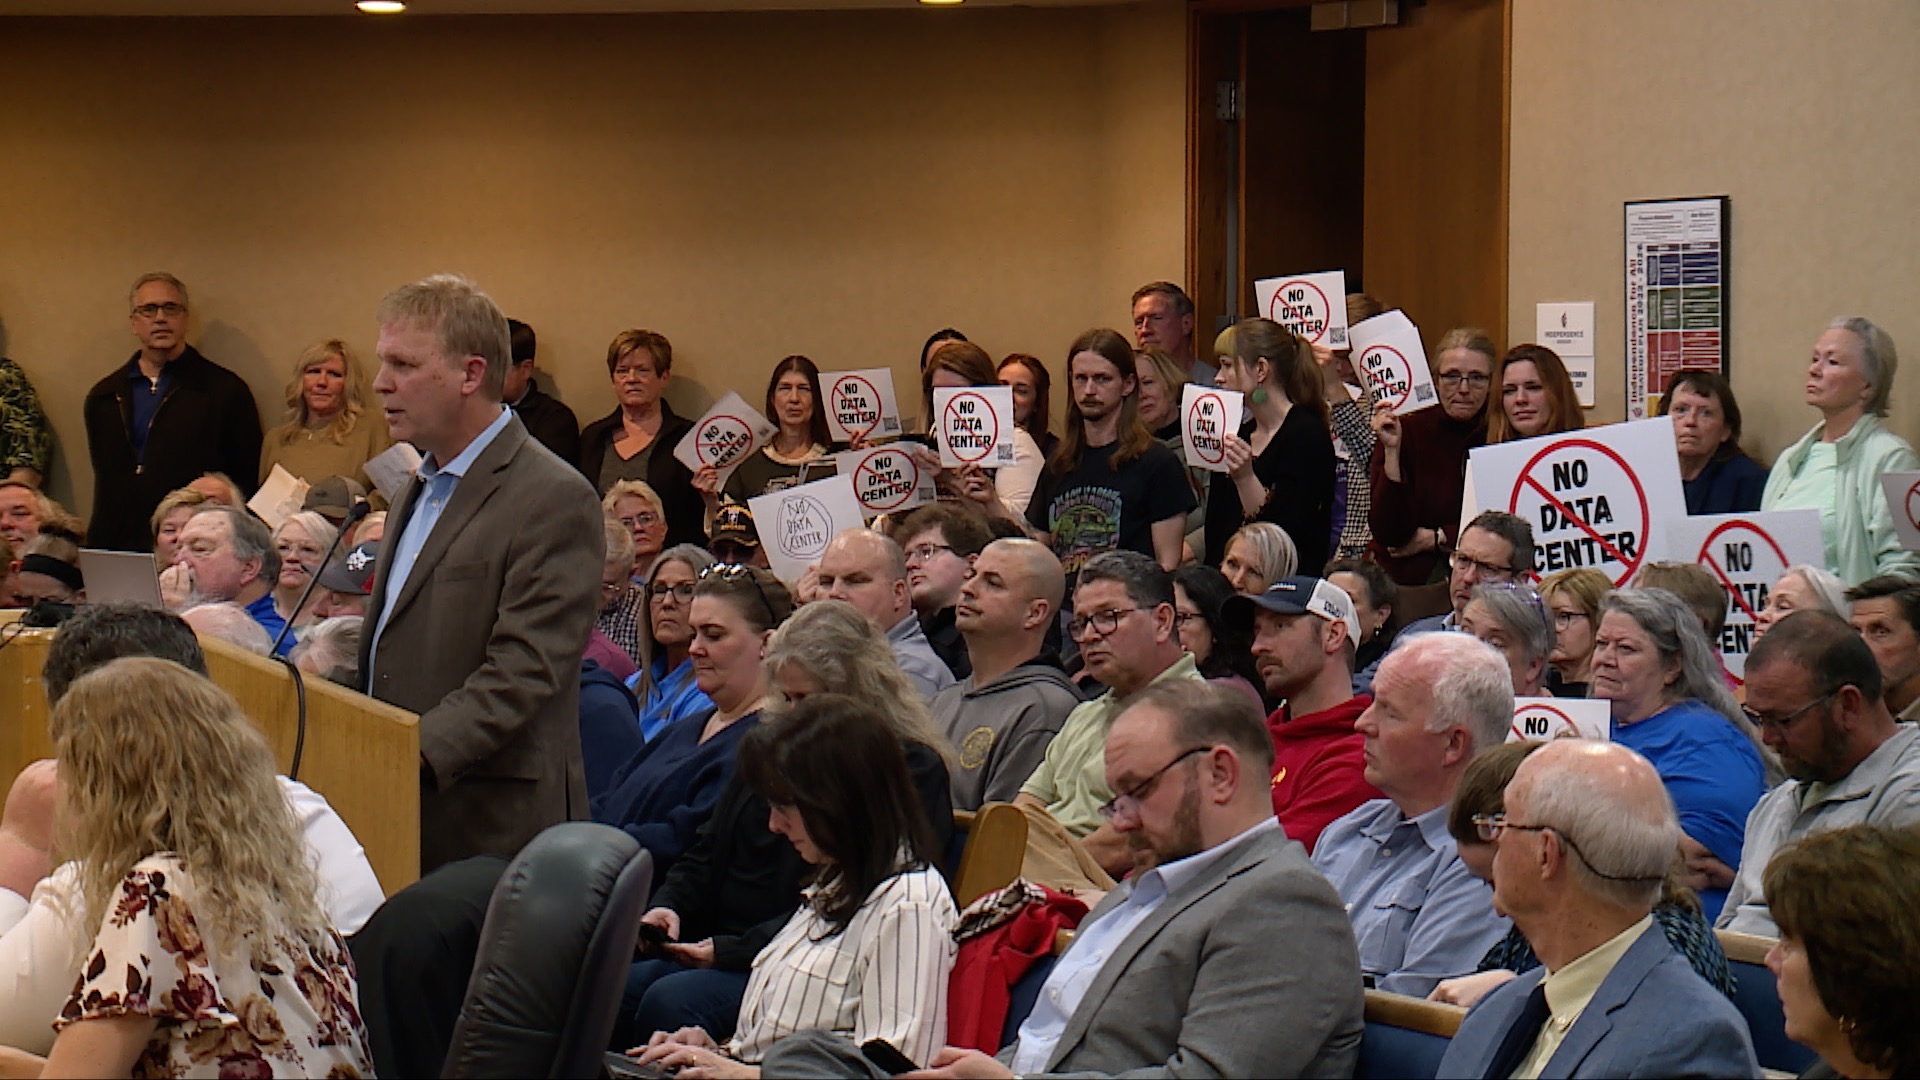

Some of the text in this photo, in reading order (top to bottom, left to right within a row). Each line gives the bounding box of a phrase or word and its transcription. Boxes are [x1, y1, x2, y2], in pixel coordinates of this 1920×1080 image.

[1288, 289, 1304, 302] NO
[1282, 304, 1313, 320] DATA
[1284, 319, 1323, 335] ENTER
[1629, 259, 1637, 403] Independence for All
[1367, 353, 1381, 369] NO
[1367, 367, 1394, 388] DATA
[845, 383, 858, 394] NO
[1371, 381, 1408, 400] ENTER
[841, 397, 867, 410] DATA
[959, 401, 975, 414] NO
[1202, 402, 1214, 416] NO
[838, 411, 877, 424] CENTER
[953, 417, 982, 430] DATA
[704, 425, 719, 441] NO
[1197, 419, 1216, 434] DATA
[709, 431, 736, 457] DATA
[949, 435, 991, 448] CENTER
[1193, 435, 1221, 450] CENTER
[715, 433, 750, 468] CENTER
[875, 457, 892, 470] NO
[869, 469, 902, 486] DATA
[1552, 459, 1588, 491] NO
[862, 481, 911, 502] CENTER
[787, 501, 805, 516] NO
[1540, 495, 1613, 533] DATA
[786, 517, 814, 534] DATA
[790, 531, 823, 550] CENTER
[1532, 531, 1637, 572] CENTER
[1725, 542, 1752, 572] NO
[1720, 582, 1769, 612] ATA
[1525, 717, 1549, 734] NO
